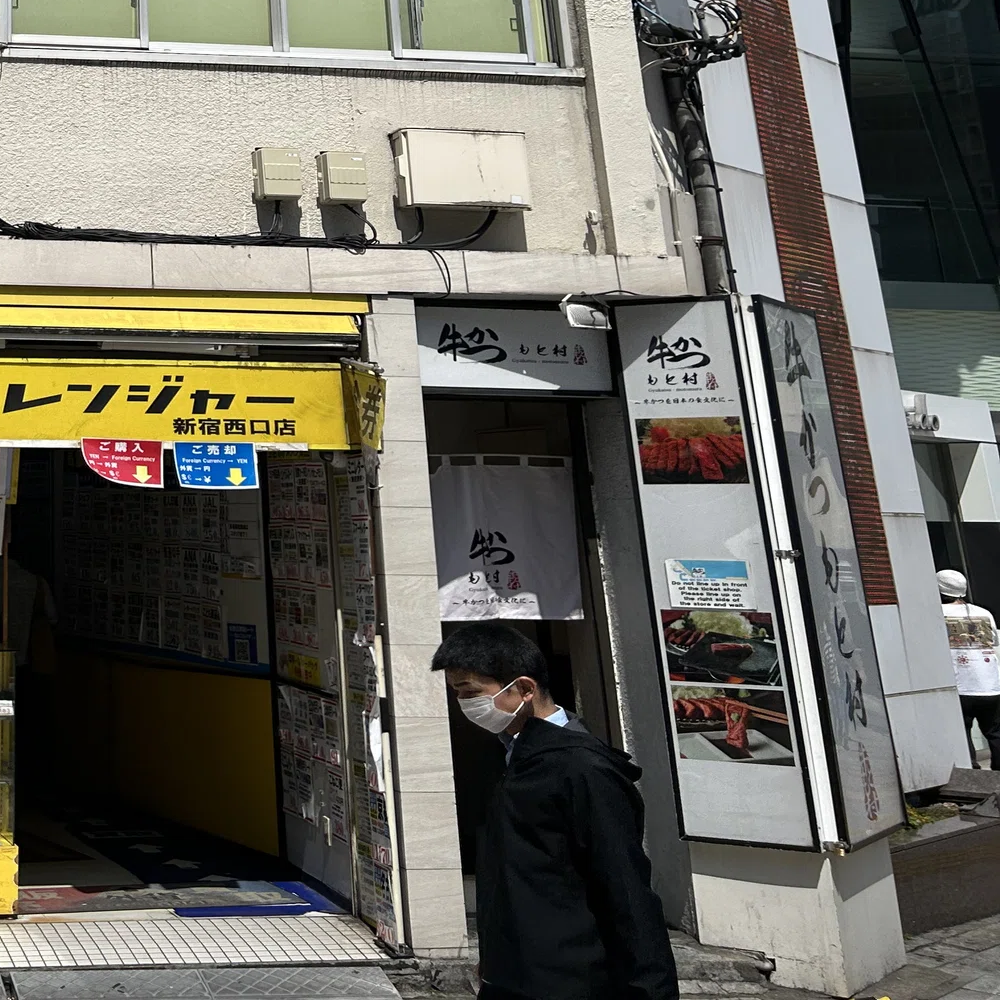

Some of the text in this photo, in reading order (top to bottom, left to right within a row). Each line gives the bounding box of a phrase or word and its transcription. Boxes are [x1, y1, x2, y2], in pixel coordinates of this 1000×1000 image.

[437, 322, 508, 364] 牛かつ
[647, 335, 711, 369] 牛かつ
[172, 417, 297, 437] 新宿西口店
[98, 440, 145, 453] ご購入
[191, 444, 237, 456] ご売却
